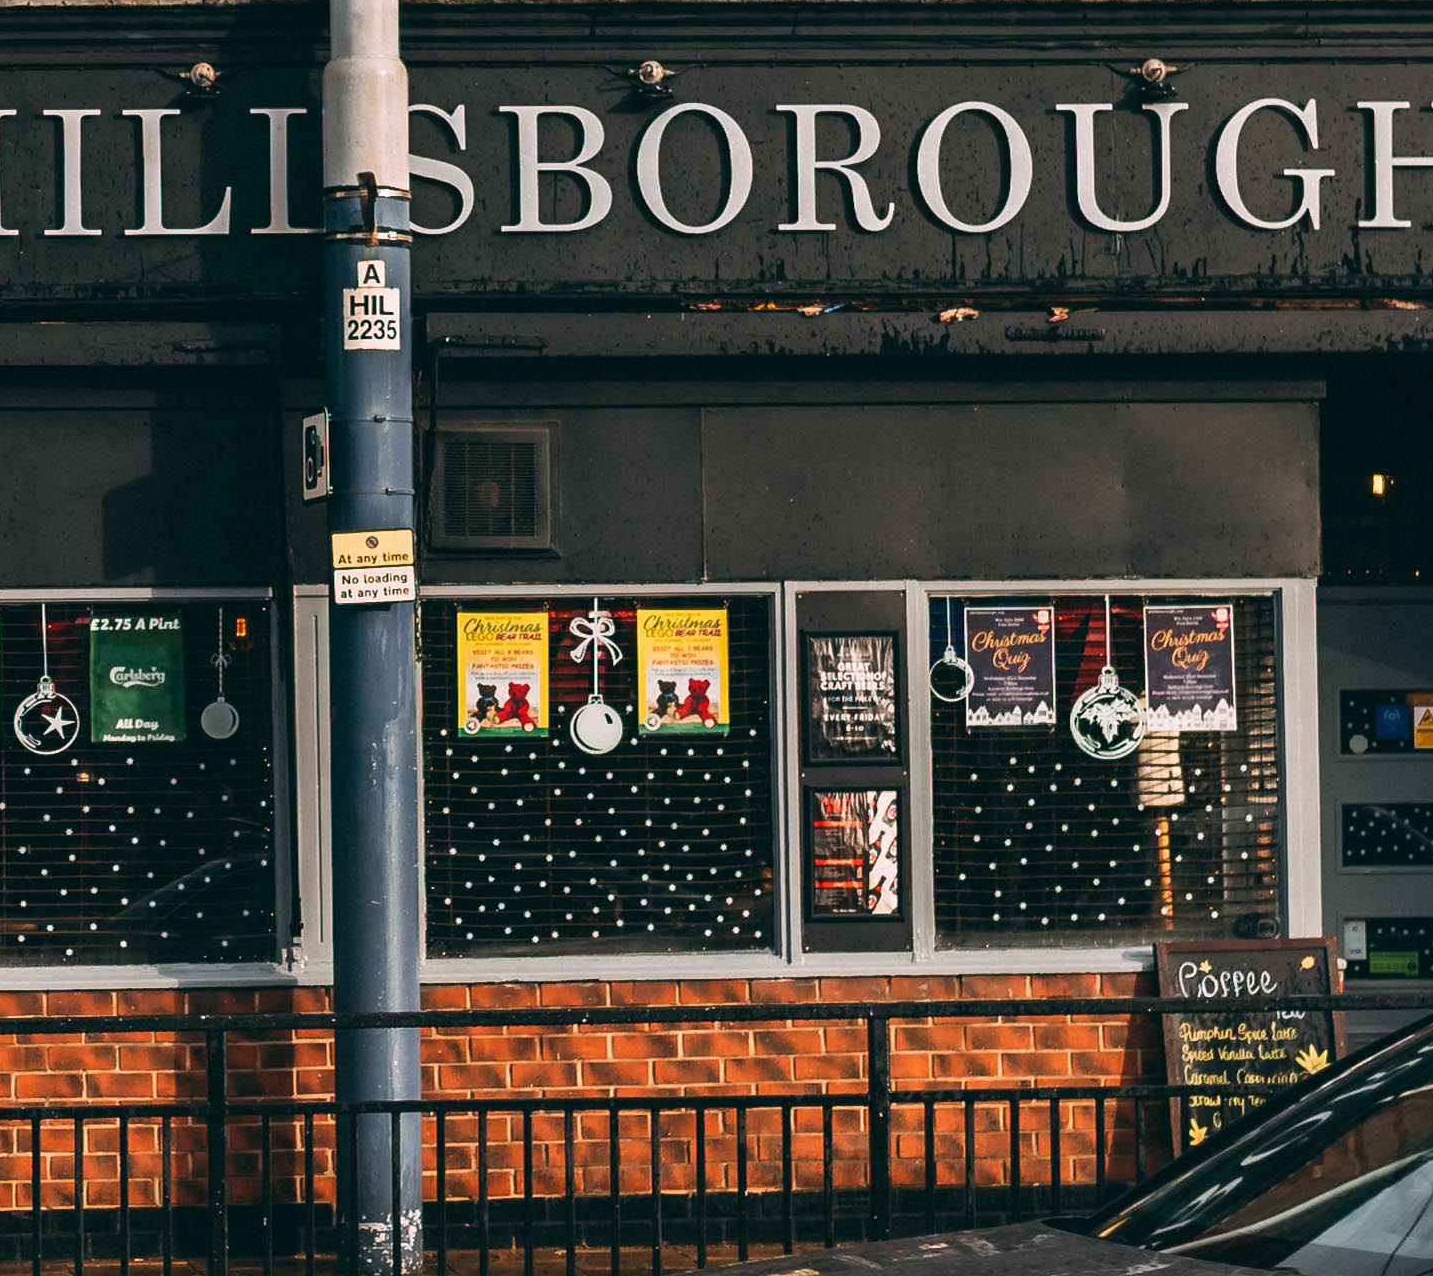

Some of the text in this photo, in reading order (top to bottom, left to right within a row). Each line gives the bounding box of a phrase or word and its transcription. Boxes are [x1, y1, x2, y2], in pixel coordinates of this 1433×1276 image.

[363, 264, 381, 284] A
[350, 295, 393, 316] HIL
[348, 320, 397, 340] 2235
[338, 551, 409, 568] At any time
[342, 571, 407, 587] No loading
[341, 585, 409, 602] at any time
[90, 618, 180, 631] £2.75 A Pint
[464, 618, 543, 634] Christmas
[644, 615, 723, 630] Christmas
[466, 632, 543, 641] LEGO BEAR TRAIL
[646, 628, 722, 638] LEGO BEAR TRAIL
[972, 630, 1046, 652] Christmas
[1151, 629, 1226, 652] Christmas
[837, 662, 870, 671] GREAT
[993, 647, 1031, 673] Quiz
[1172, 646, 1210, 672] Quiz
[109, 666, 165, 688] Carlsberg
[820, 681, 885, 691] CRAFT BEERS
[116, 719, 159, 730] All Day
[824, 713, 885, 722] EVERY FRIDAY
[103, 734, 136, 742] Monday
[147, 733, 175, 742] Friday
[1179, 961, 1277, 998] Coffee
[1180, 1021, 1297, 1044] Pumpkin Spice Latte
[1182, 1044, 1286, 1063] Spiced Vanilla Latte
[1184, 1065, 1230, 1085] Caramel
